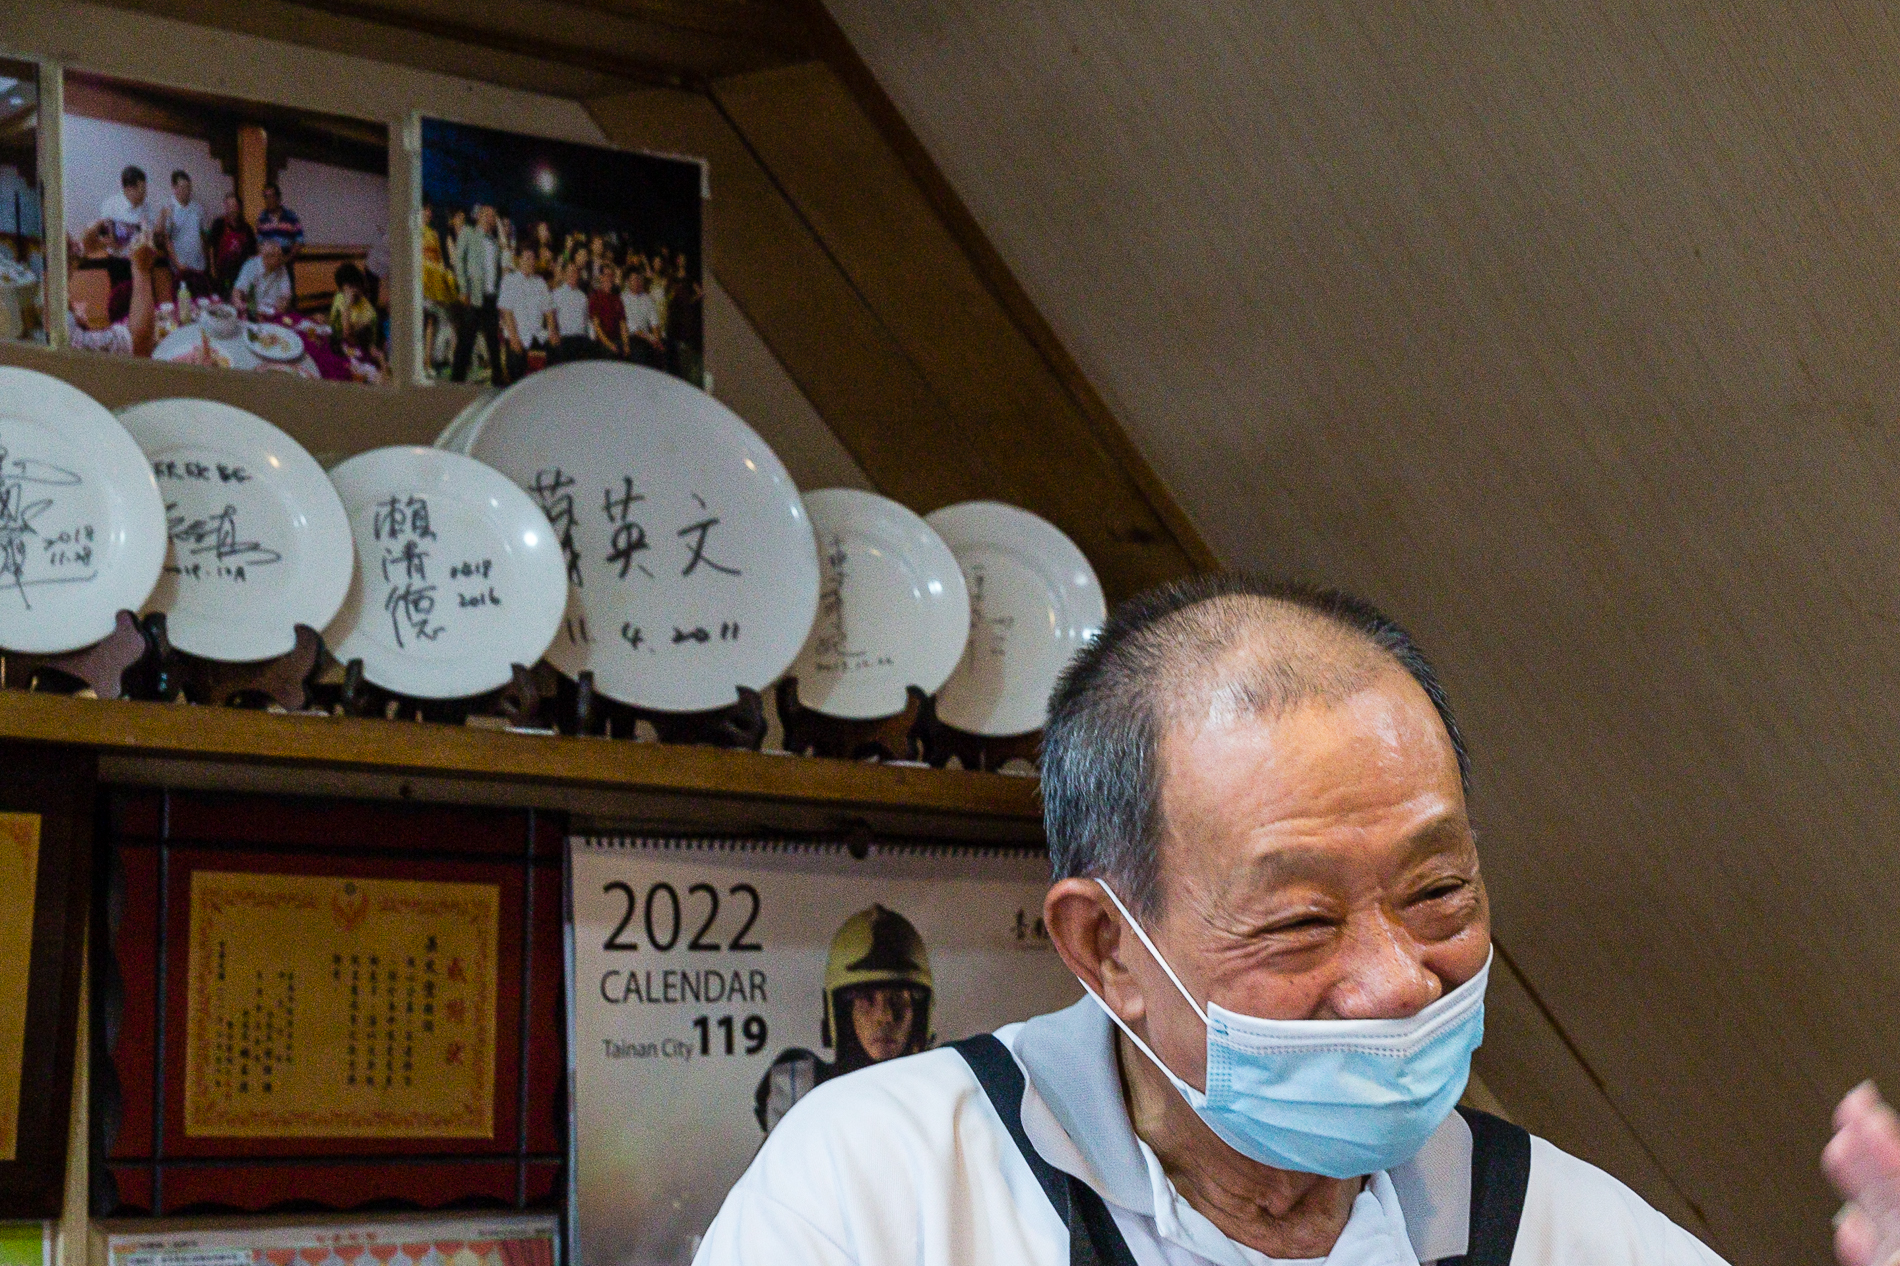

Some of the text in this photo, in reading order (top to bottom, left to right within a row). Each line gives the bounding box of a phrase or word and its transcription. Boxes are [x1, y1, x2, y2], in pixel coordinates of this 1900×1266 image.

[602, 880, 764, 953] 2022
[600, 969, 768, 1005] CALENDAR
[602, 1014, 768, 1062] Tainan City 119
